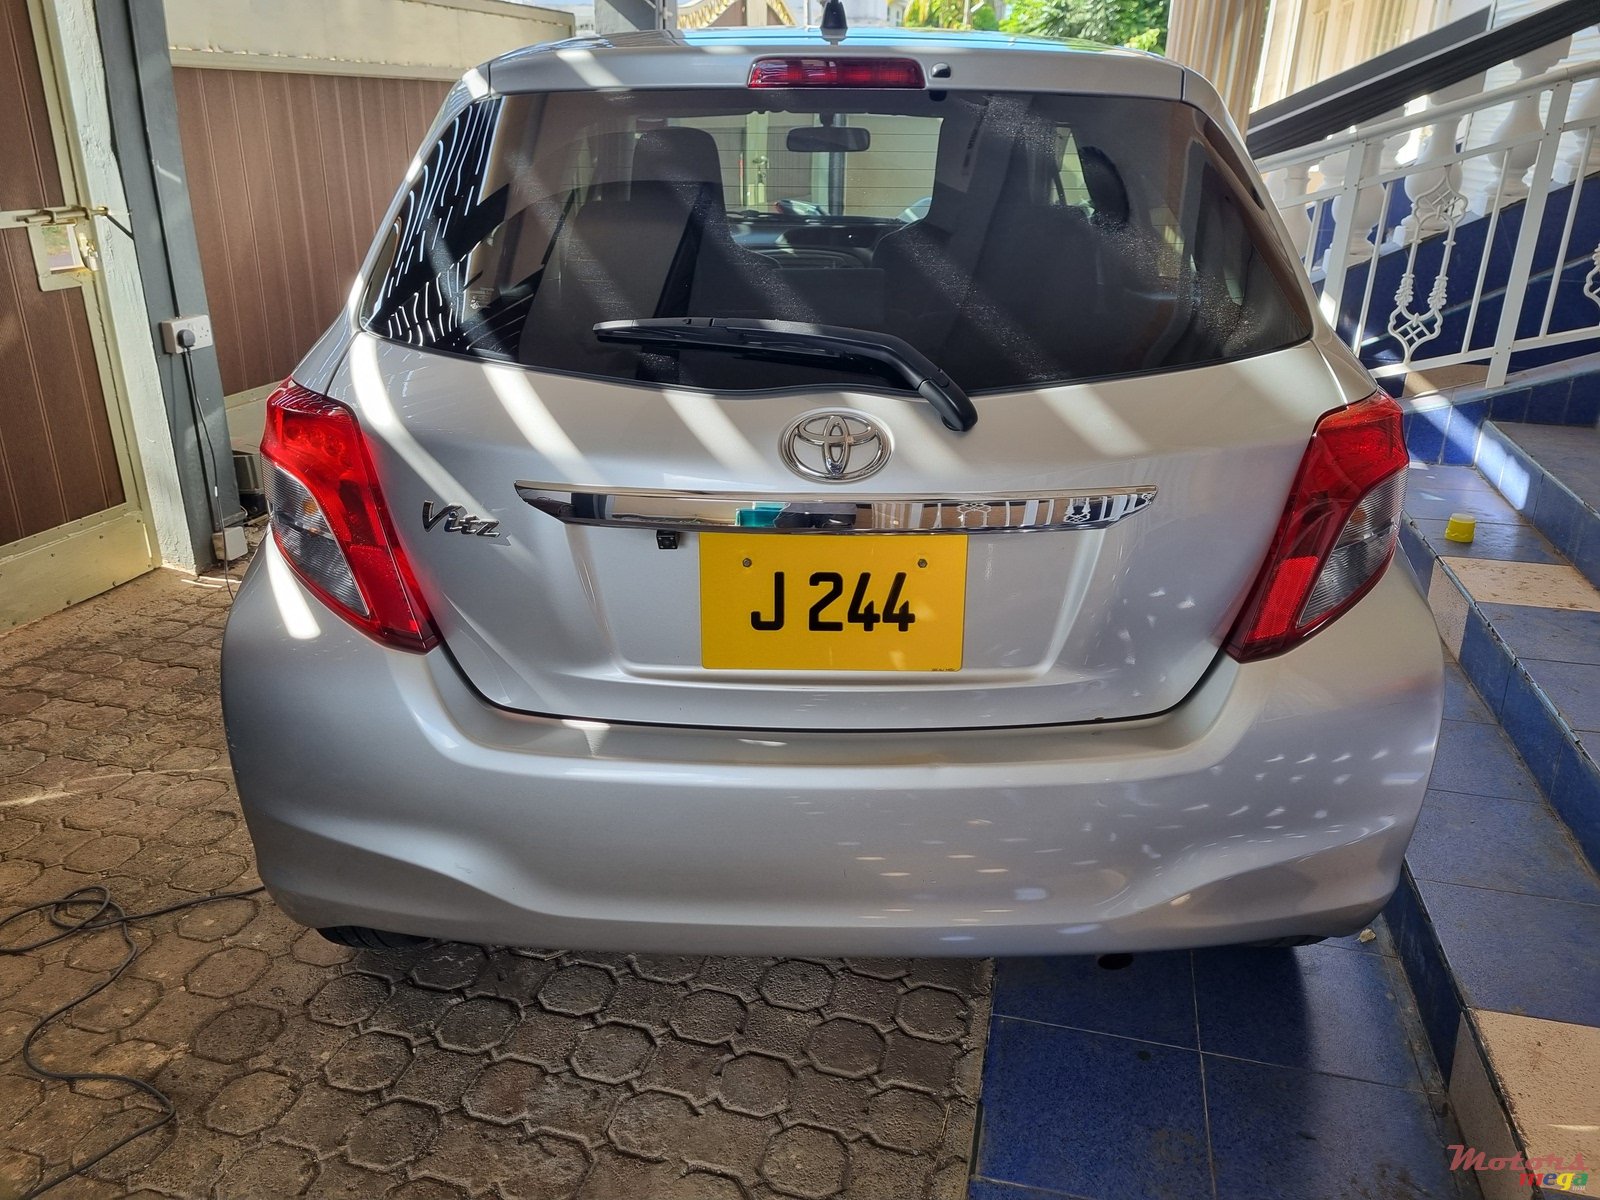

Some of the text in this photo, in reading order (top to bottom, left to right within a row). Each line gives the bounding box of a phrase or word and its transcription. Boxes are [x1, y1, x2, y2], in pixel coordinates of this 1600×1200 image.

[422, 500, 501, 538] Vitz
[750, 571, 916, 632] J 244
